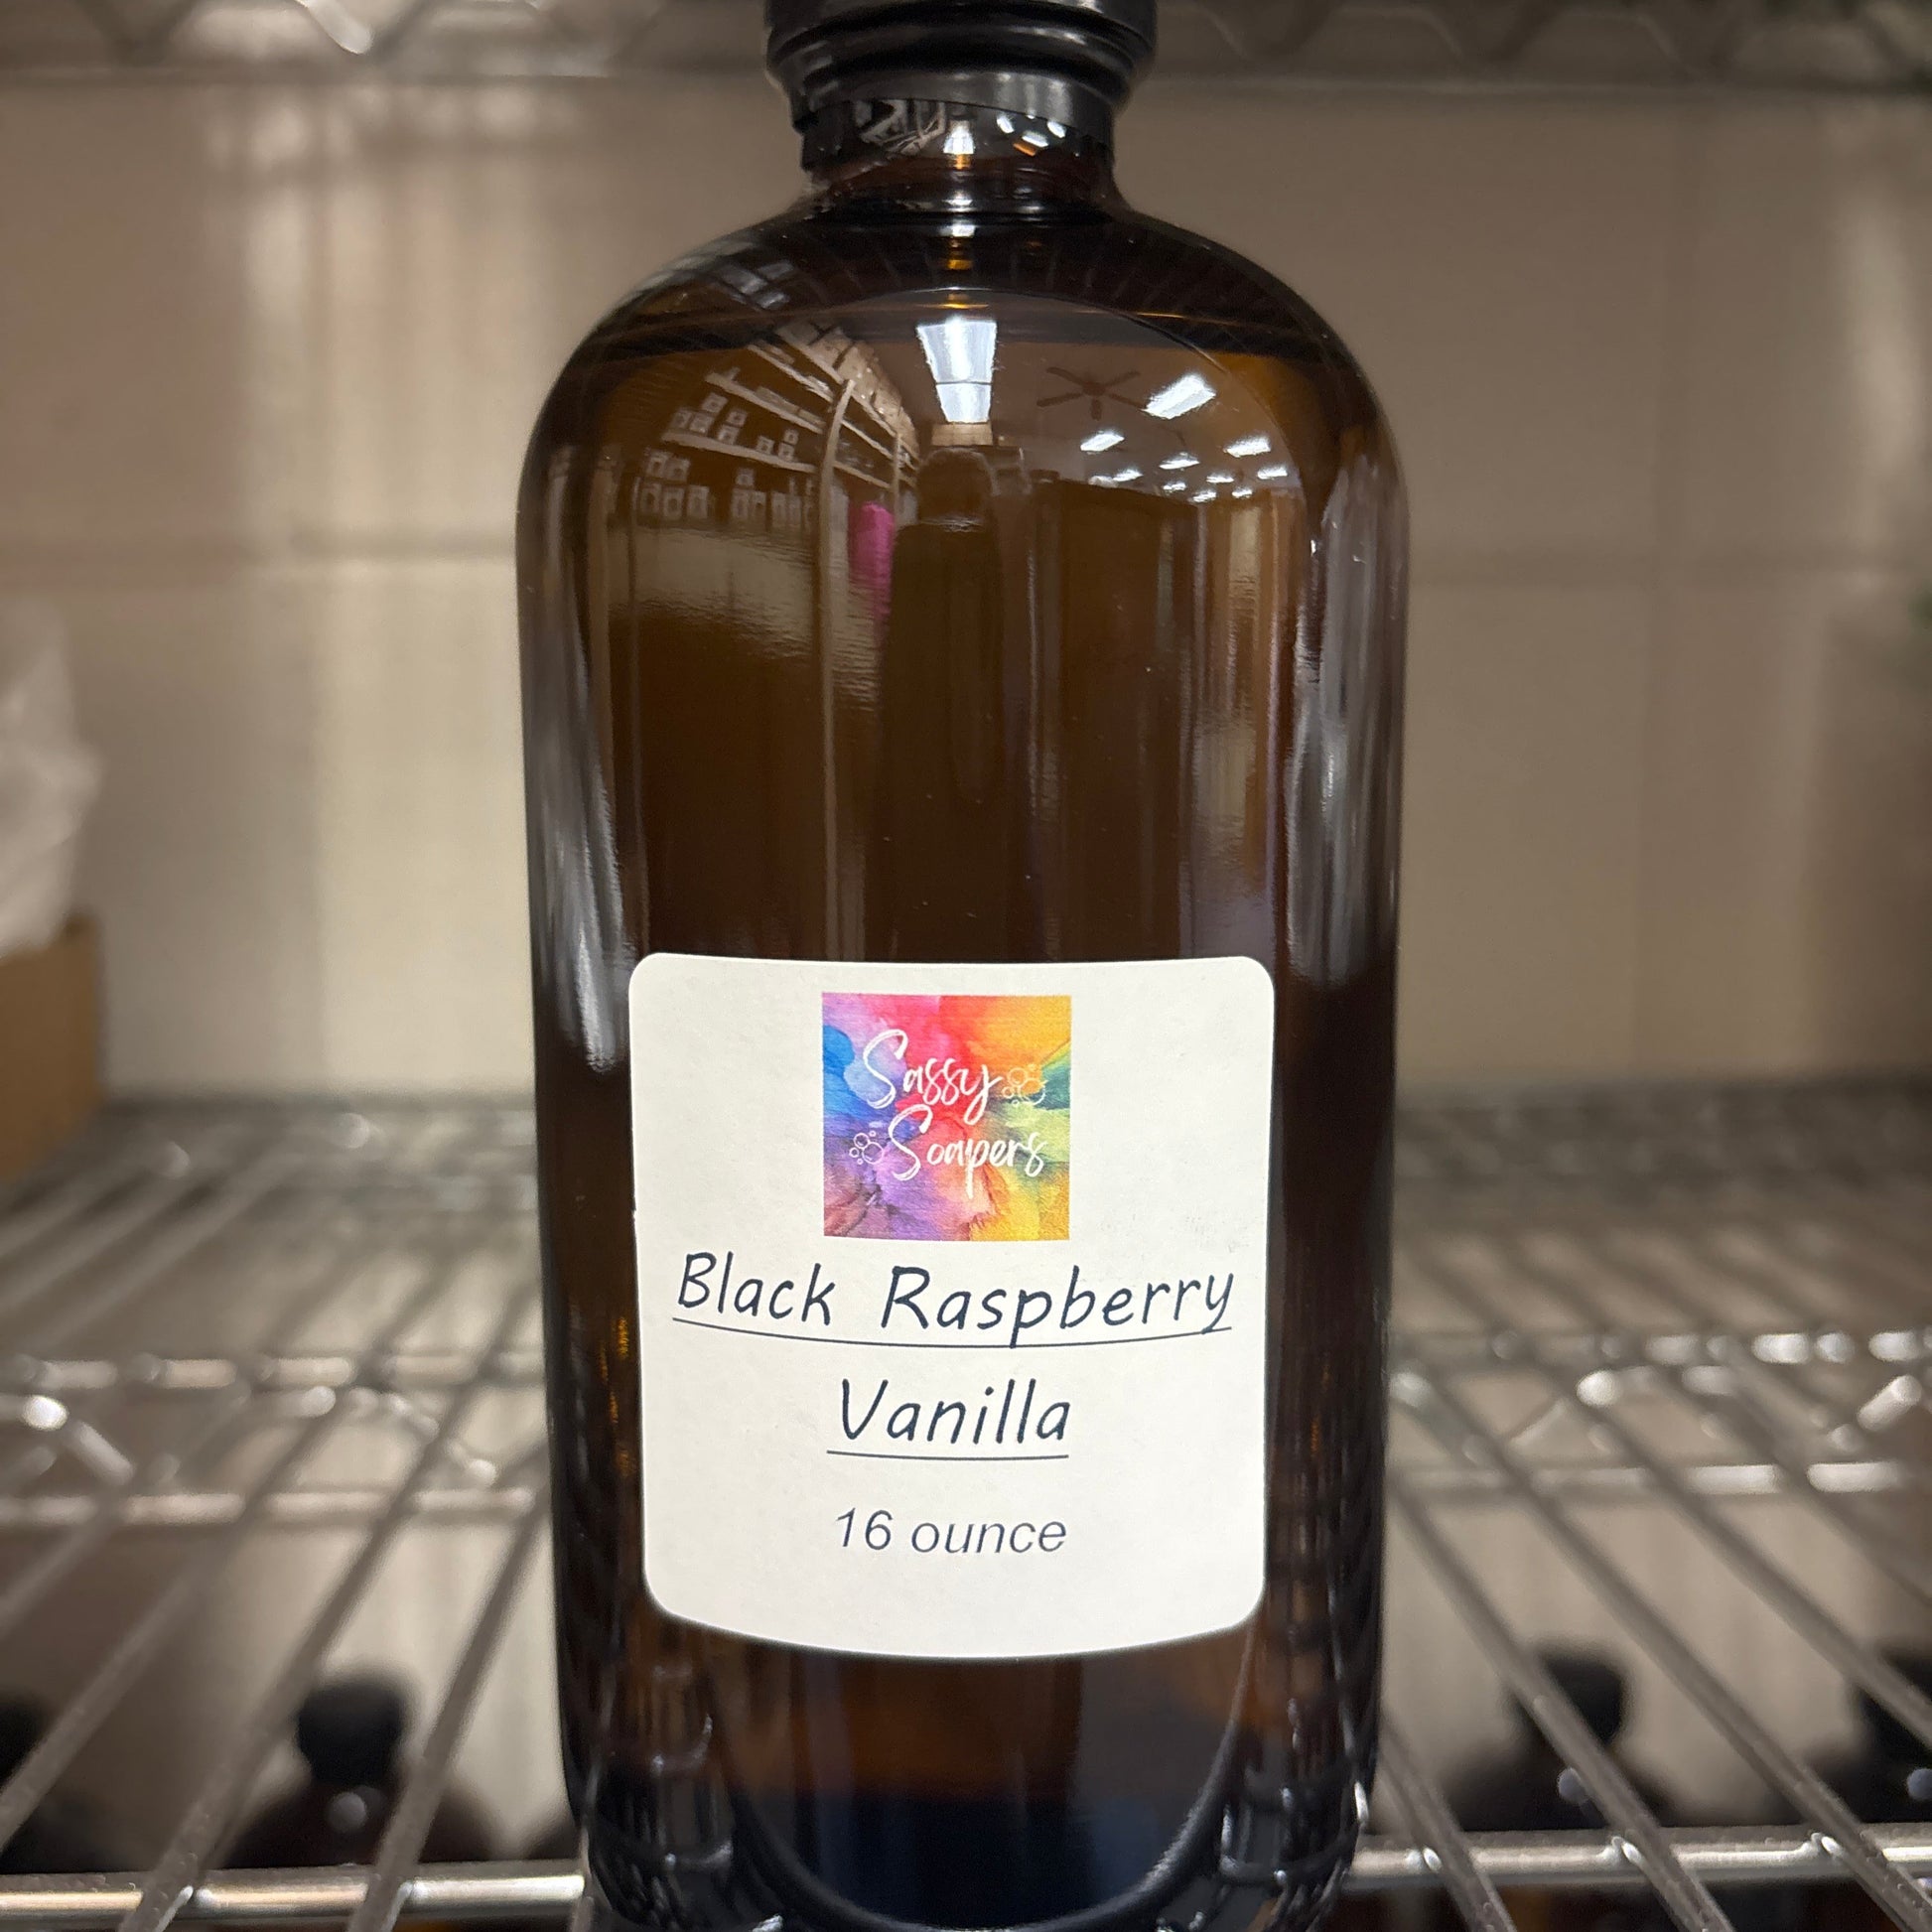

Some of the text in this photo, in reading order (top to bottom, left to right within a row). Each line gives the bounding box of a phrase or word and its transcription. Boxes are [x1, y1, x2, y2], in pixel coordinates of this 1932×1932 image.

[863, 1028, 1003, 1126] Sassy
[888, 1103, 1047, 1199] Soapers
[677, 1251, 1234, 1348] Black Raspberry
[841, 1378, 1071, 1446] Vanilla
[835, 1509, 1067, 1555] 16 ounce
